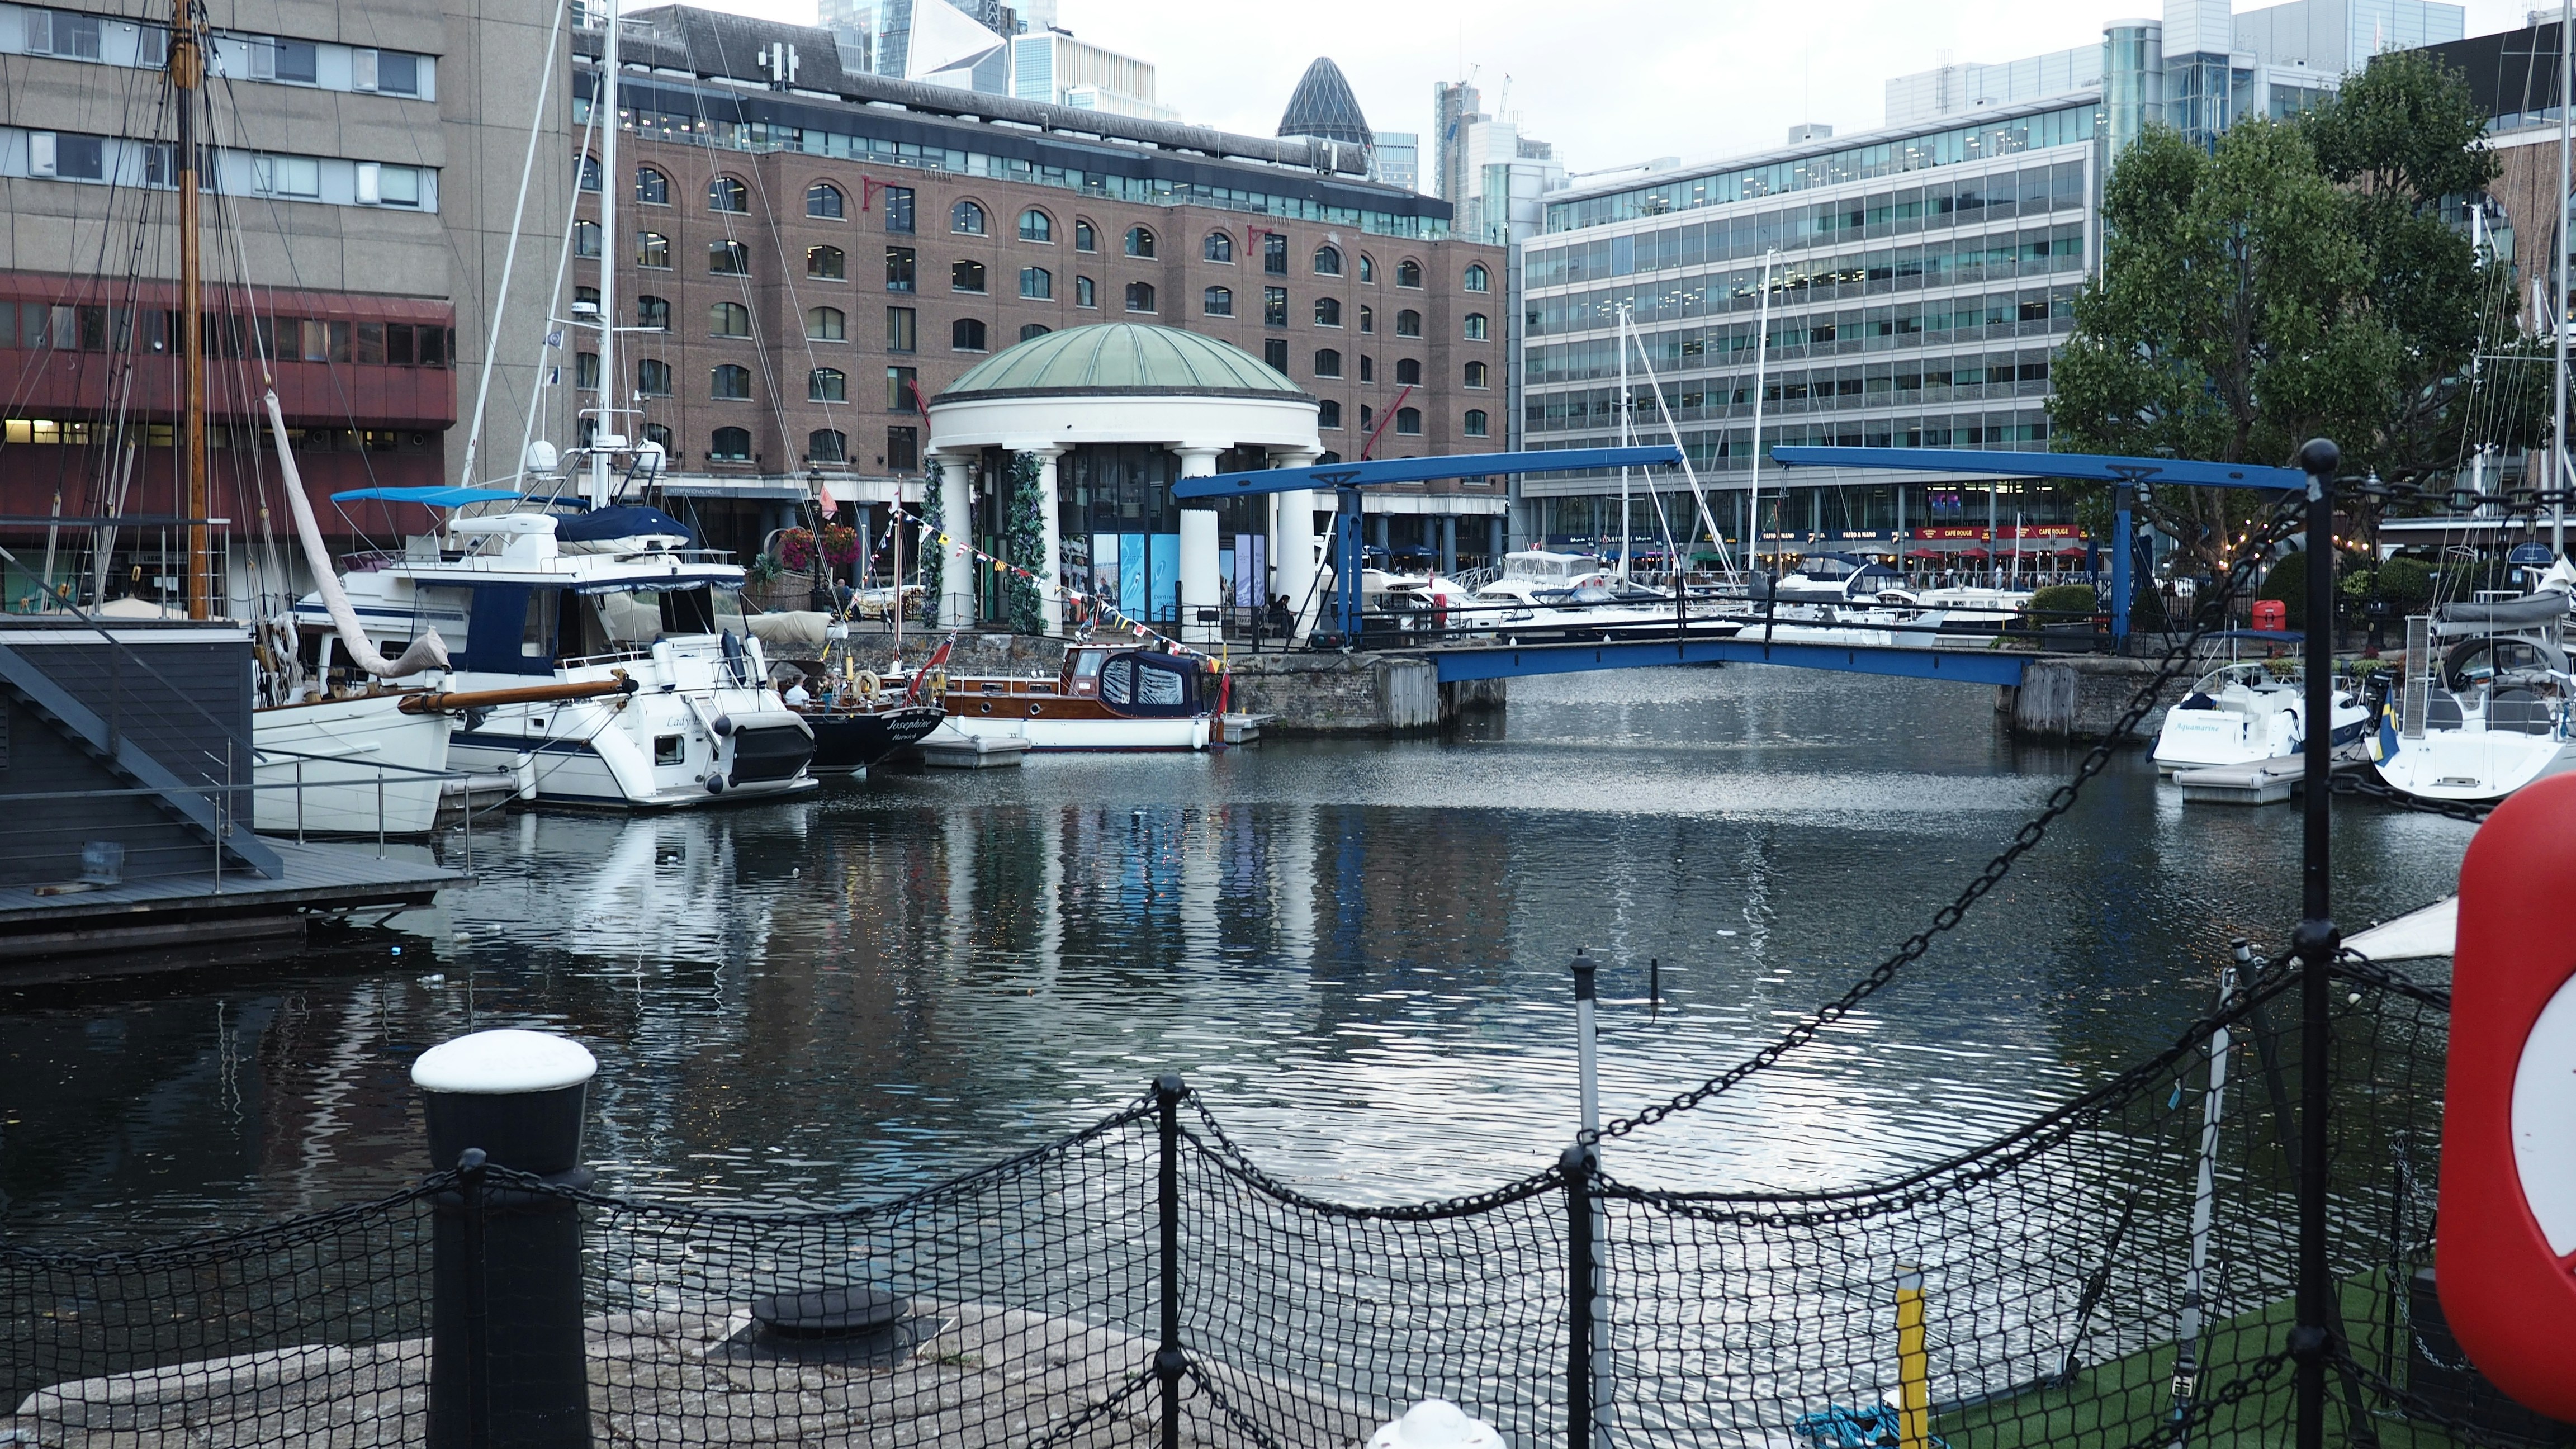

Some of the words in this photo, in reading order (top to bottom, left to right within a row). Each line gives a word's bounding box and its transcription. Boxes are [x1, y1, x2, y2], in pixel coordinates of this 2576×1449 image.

[667, 714, 690, 730] Lady
[887, 718, 931, 731] Josephine
[2175, 723, 2219, 732] Aquamarine
